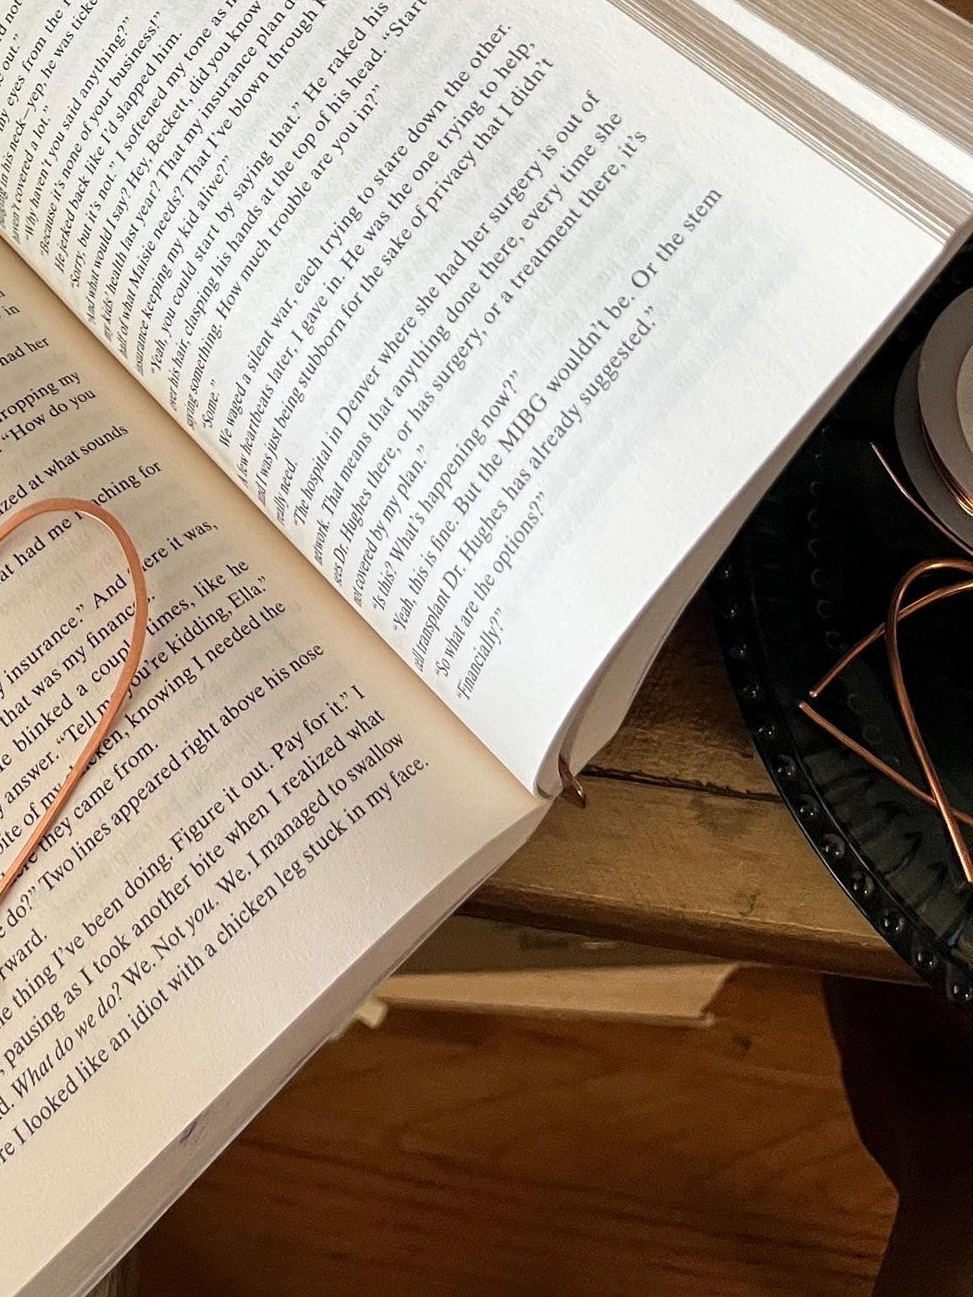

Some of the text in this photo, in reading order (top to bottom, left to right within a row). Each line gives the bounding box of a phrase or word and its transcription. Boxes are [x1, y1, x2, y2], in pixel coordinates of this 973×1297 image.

[114, 149, 127, 162] I
[122, 84, 168, 153] softened
[164, 61, 186, 88] my
[182, 27, 212, 62] tone
[210, 7, 227, 27] as
[171, 259, 197, 306] could
[193, 223, 220, 262] start
[213, 200, 235, 223] by
[232, 149, 274, 201] saying
[301, 76, 328, 103] He
[326, 25, 367, 76] raked
[361, 1, 389, 28] his
[246, 328, 275, 374] silent
[269, 296, 298, 328] war,
[293, 255, 324, 294] each
[318, 204, 363, 255] trying
[355, 185, 375, 205] to
[372, 144, 408, 186] stare
[406, 99, 448, 144] down
[442, 70, 470, 98] the
[469, 23, 511, 69] other.
[22, 336, 49, 353] her
[56, 371, 81, 387] my
[407, 564, 429, 596] this
[419, 549, 437, 568] is
[429, 519, 460, 553] fine.
[451, 480, 482, 516] But
[476, 452, 503, 483] the
[496, 391, 548, 454] MIBG
[602, 295, 636, 319] be.
[630, 261, 658, 289] Or
[654, 232, 684, 262] the
[682, 188, 723, 232] stem
[443, 623, 466, 659] what
[459, 599, 479, 628] are
[472, 572, 495, 602] the
[10, 1124, 27, 1145] I
[21, 1072, 79, 1136] looked
[73, 1048, 109, 1084] like
[108, 1026, 132, 1052] an
[126, 987, 169, 1031] idiot
[165, 953, 205, 992] with
[203, 942, 218, 958] a
[216, 884, 278, 945] chicken
[272, 858, 307, 888] leg
[301, 819, 348, 864] stuck
[342, 804, 367, 825] in
[364, 781, 392, 809] my
[388, 758, 429, 788] face.
[11, 964, 58, 1009] thing
[80, 896, 125, 937] been
[123, 852, 174, 899] doing.
[168, 800, 225, 854] Figure
[221, 785, 241, 804] it
[240, 760, 274, 789] out.
[269, 730, 305, 761] Pay
[301, 710, 329, 736] for
[349, 683, 365, 700] I
